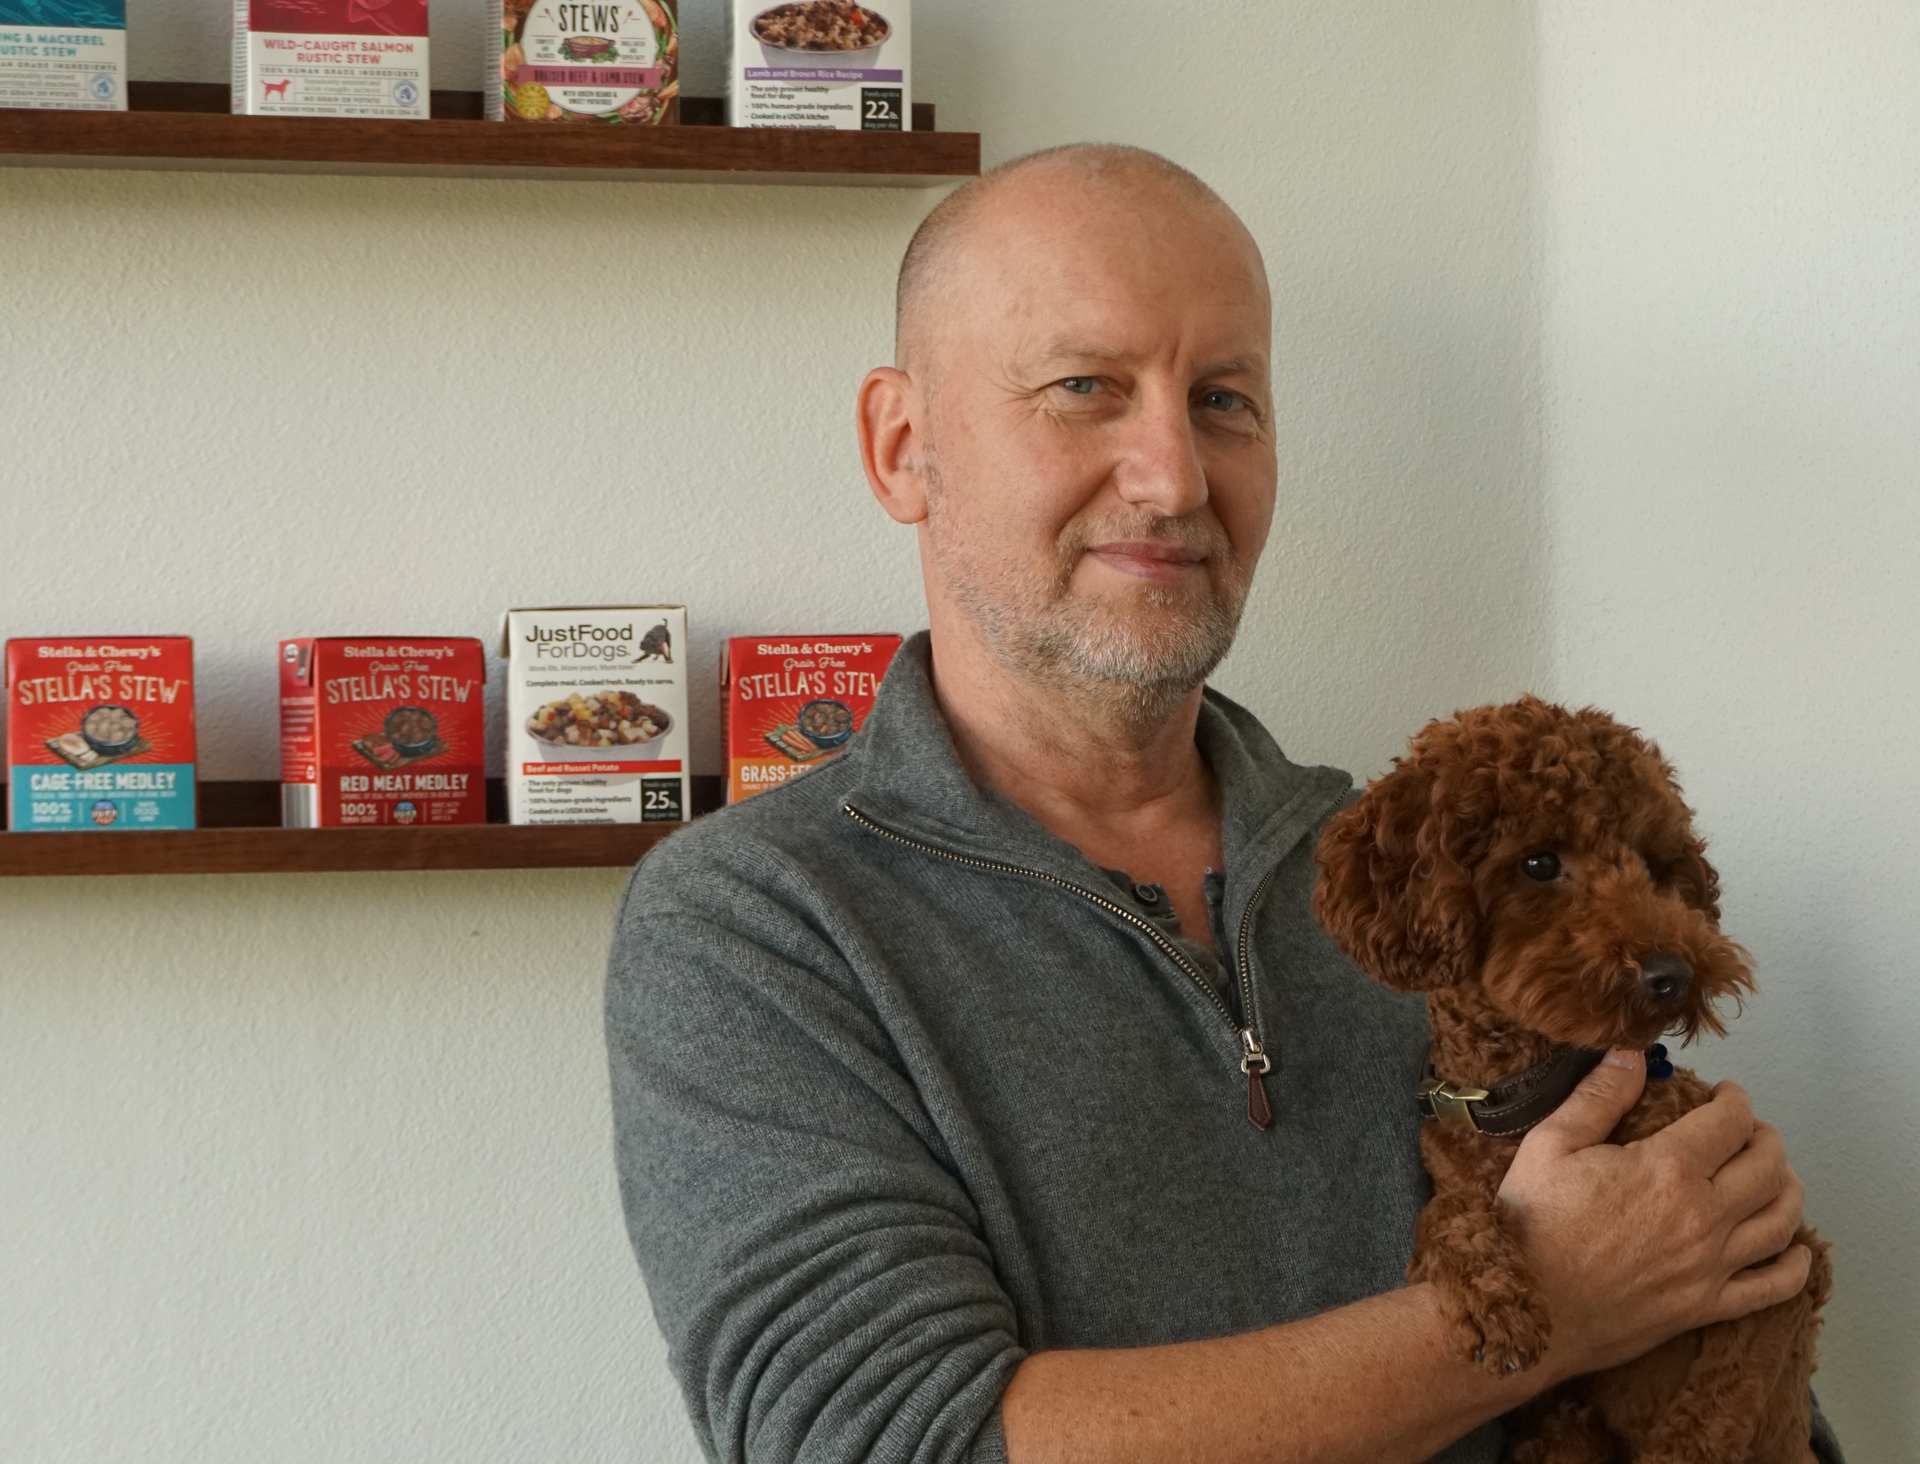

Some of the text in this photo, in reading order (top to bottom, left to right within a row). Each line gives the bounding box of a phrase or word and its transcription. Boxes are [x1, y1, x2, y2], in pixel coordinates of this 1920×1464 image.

[558, 4, 619, 33] STEWS
[38, 34, 105, 46] MACKEREL
[263, 38, 414, 53] WILD-CAUGHT SALMON
[43, 47, 77, 57] STEW
[297, 53, 381, 65] RUSTIC STEW
[624, 73, 644, 84] STEW
[836, 71, 864, 80] Recipe
[804, 86, 830, 94] healthy
[865, 101, 890, 119] 22
[526, 624, 633, 642] JustFood
[38, 645, 162, 660] Stella & Chewy's
[344, 646, 454, 659] Stella & Chewy's
[757, 643, 872, 656] Stella & Chewy's
[66, 660, 134, 675] Grain Free
[369, 660, 430, 674] Grain Free
[783, 657, 846, 671] Grain Free
[18, 675, 180, 706] STELLA'S STEW
[326, 674, 472, 704] STELLA'S STEW
[738, 671, 826, 700] STELLA'S
[741, 765, 814, 782] GRASS-F
[30, 772, 176, 791] CAGE-FREE MEDLEY
[340, 774, 468, 792] RED MEAT MEDLEY
[645, 791, 670, 809] 25
[32, 802, 72, 815] 100%
[341, 803, 378, 816] 100%
